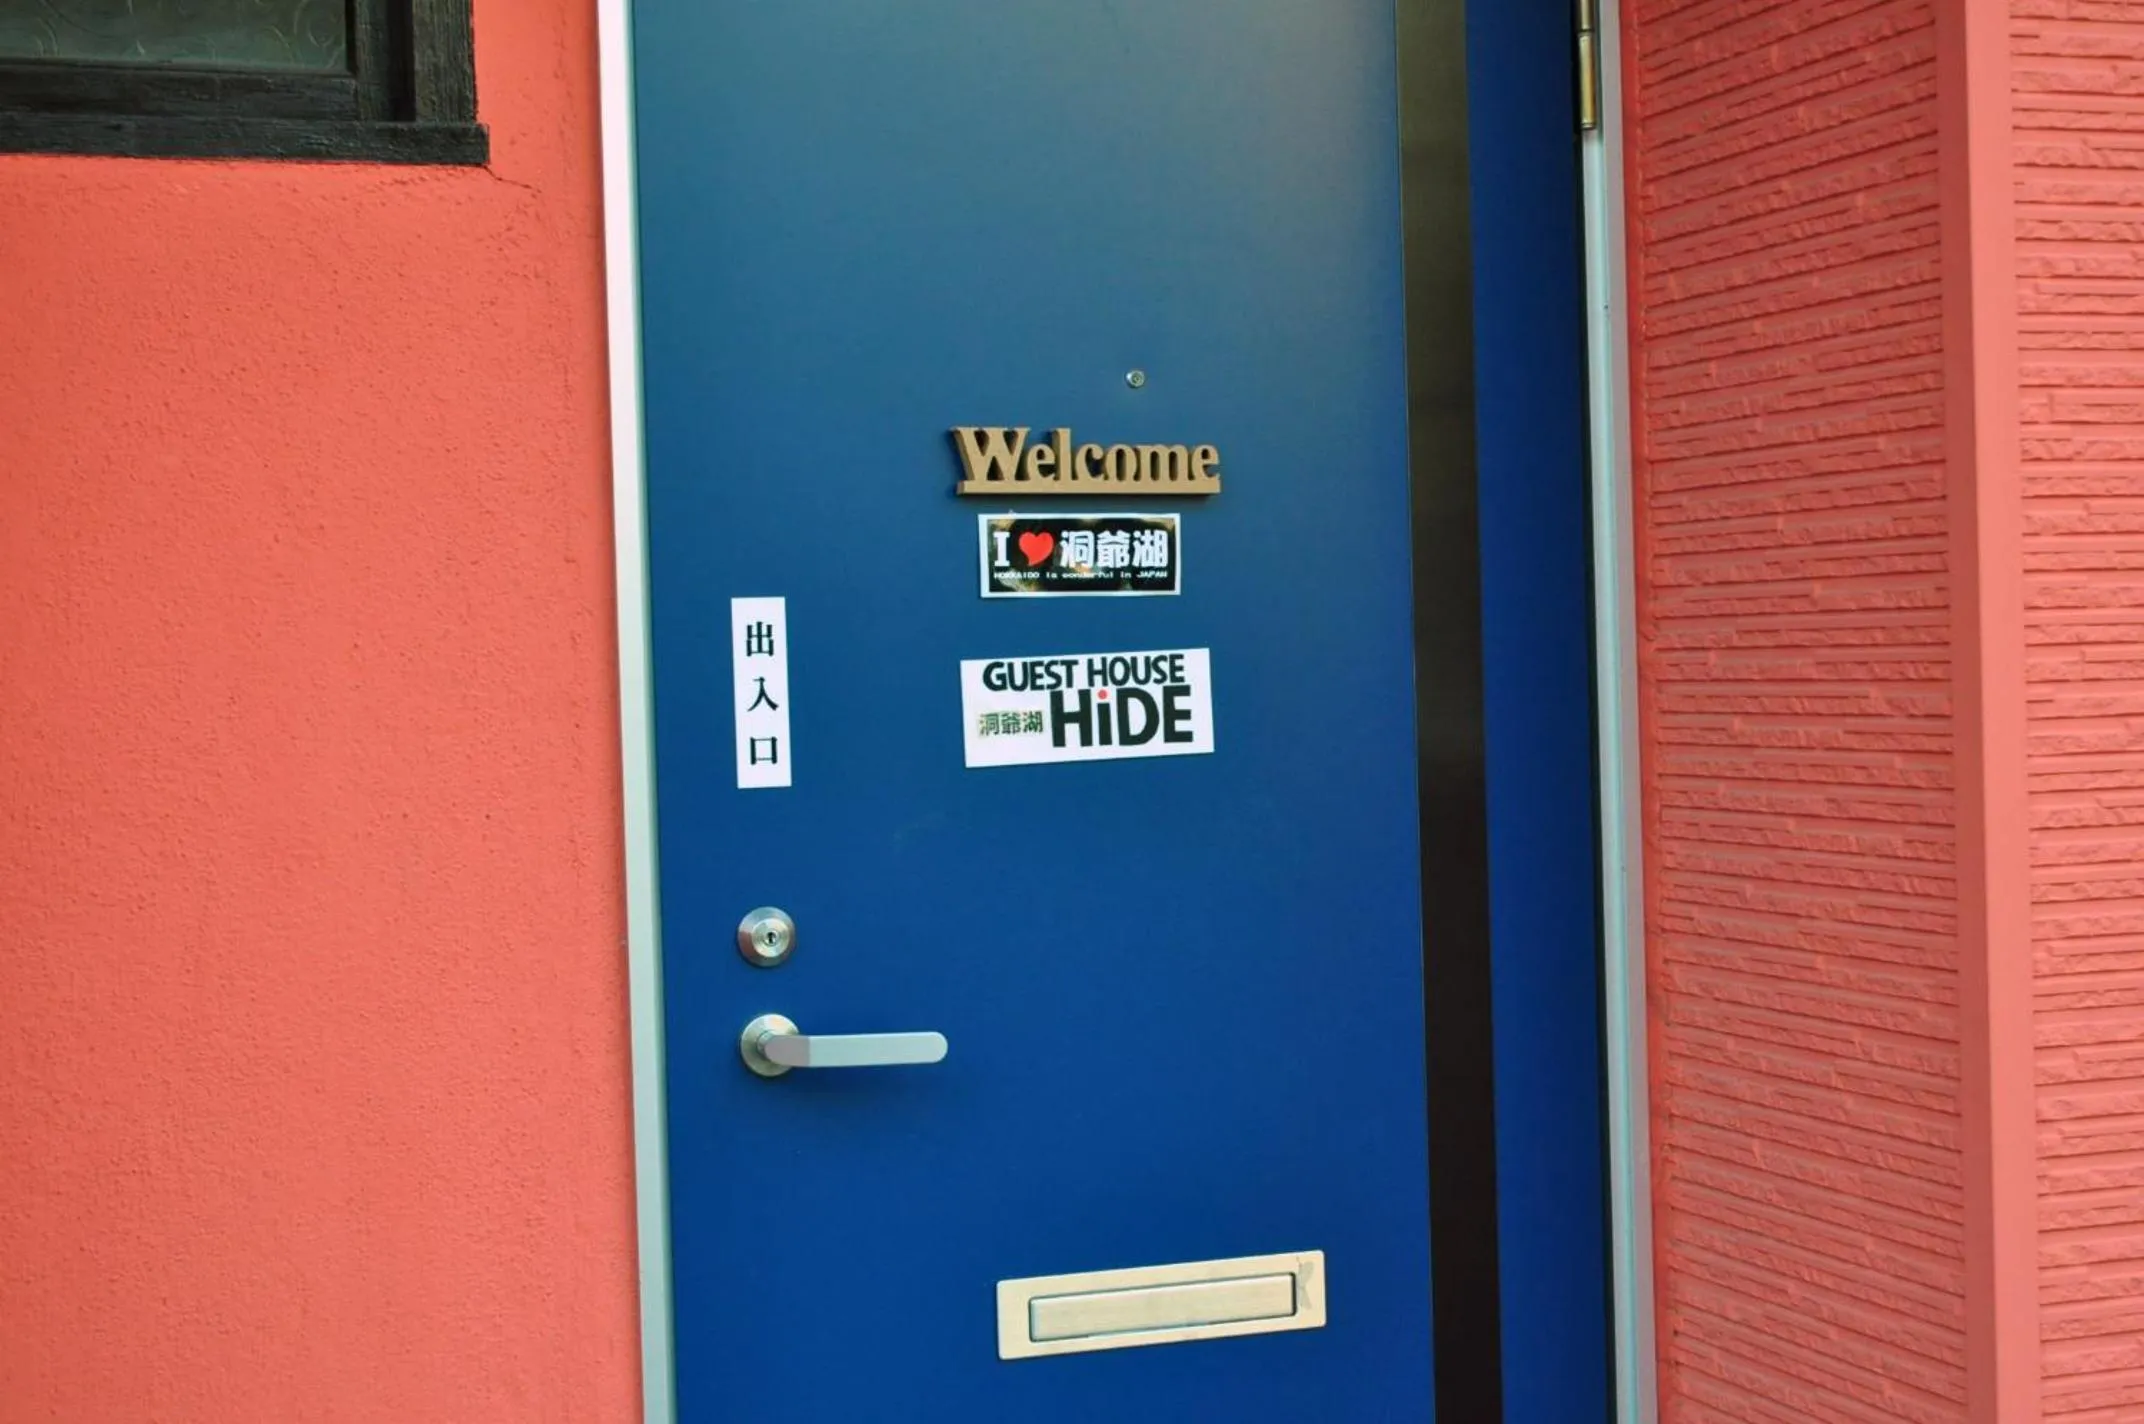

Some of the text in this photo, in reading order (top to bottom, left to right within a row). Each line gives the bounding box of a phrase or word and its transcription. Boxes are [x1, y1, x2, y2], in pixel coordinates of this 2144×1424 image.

[953, 426, 1220, 486] Welcome
[993, 529, 1169, 568] I 洞爺湖
[994, 571, 1040, 579] HOKKAIDO
[982, 653, 1185, 692] GUEST HOUSE
[746, 621, 779, 766] 出入口
[979, 711, 1043, 736] 洞爺湖
[1050, 685, 1193, 747] HiDE
